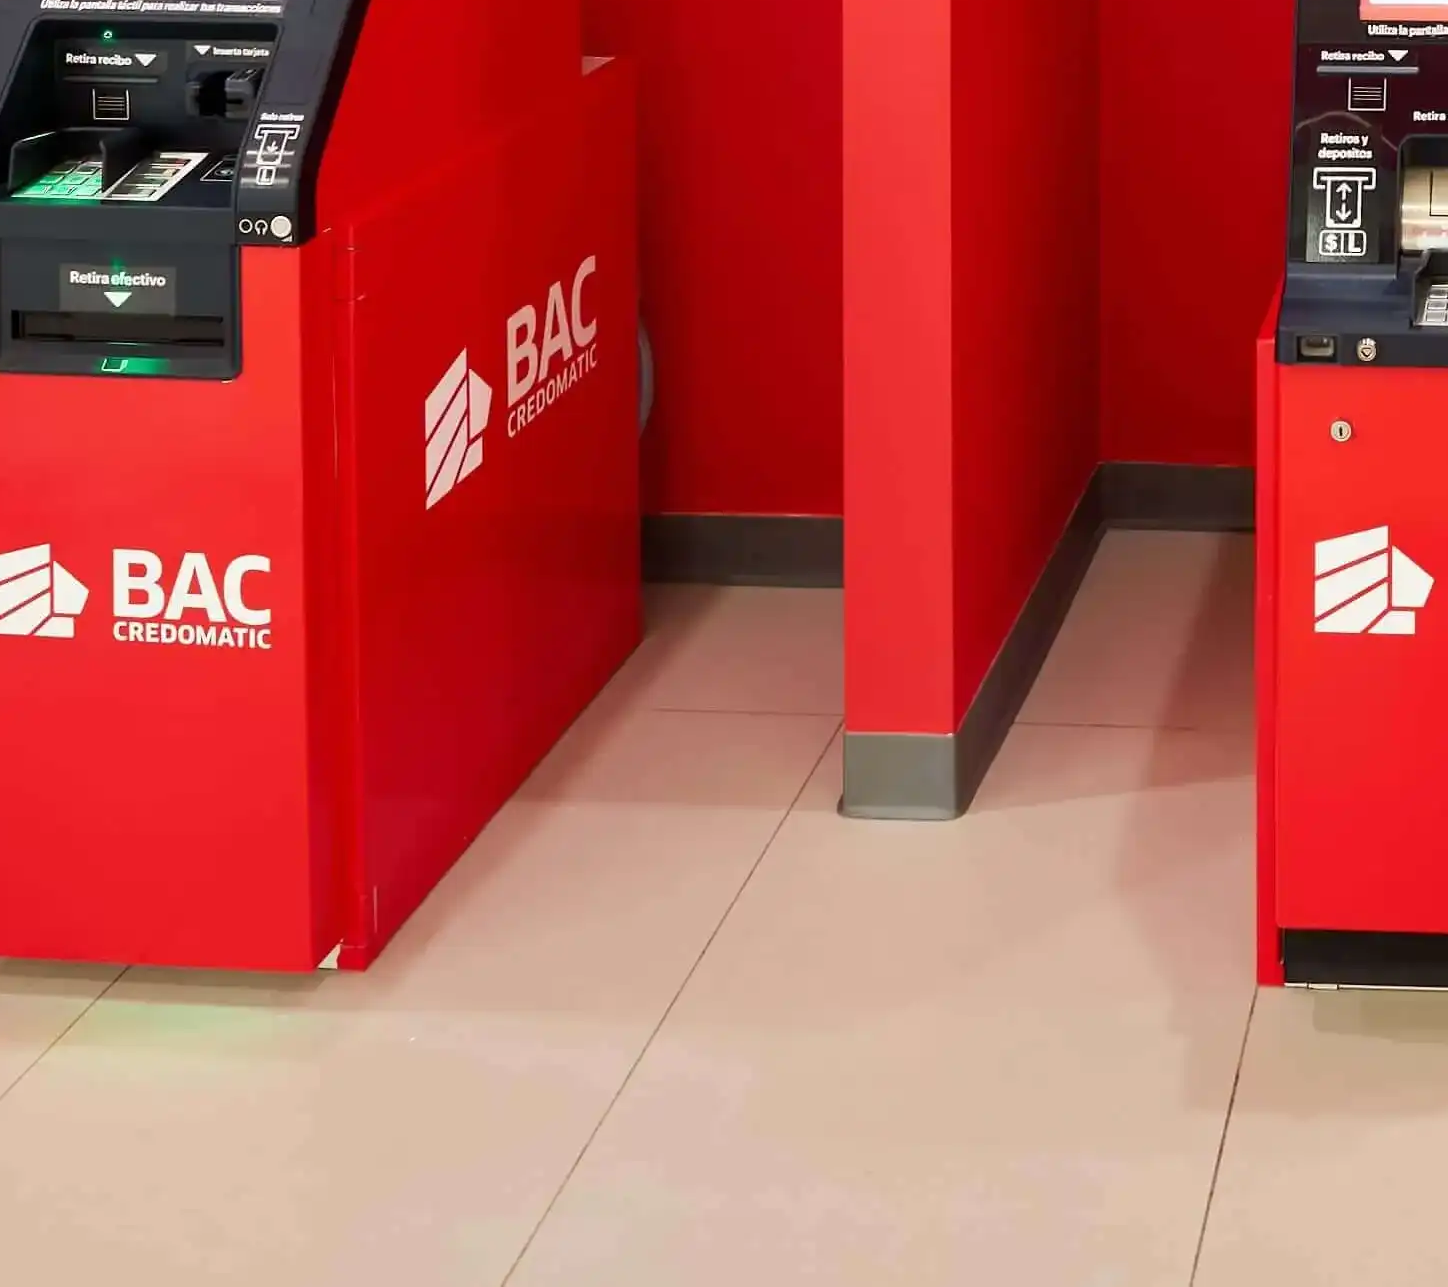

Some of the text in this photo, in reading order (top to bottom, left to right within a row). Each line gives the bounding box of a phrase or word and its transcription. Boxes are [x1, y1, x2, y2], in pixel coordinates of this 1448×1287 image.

[1368, 25, 1398, 36] Utiliza
[65, 53, 133, 66] Retira recibo
[1413, 111, 1446, 122] Retira
[1320, 133, 1369, 147] Retiros y
[261, 169, 271, 182] L
[1324, 233, 1362, 254] $ L
[69, 271, 166, 287] Retira efectivo
[505, 254, 597, 406] BAC
[506, 343, 598, 438] CREDOMATIC
[112, 548, 272, 626] BAC
[112, 620, 272, 650] CREDOMATIC
